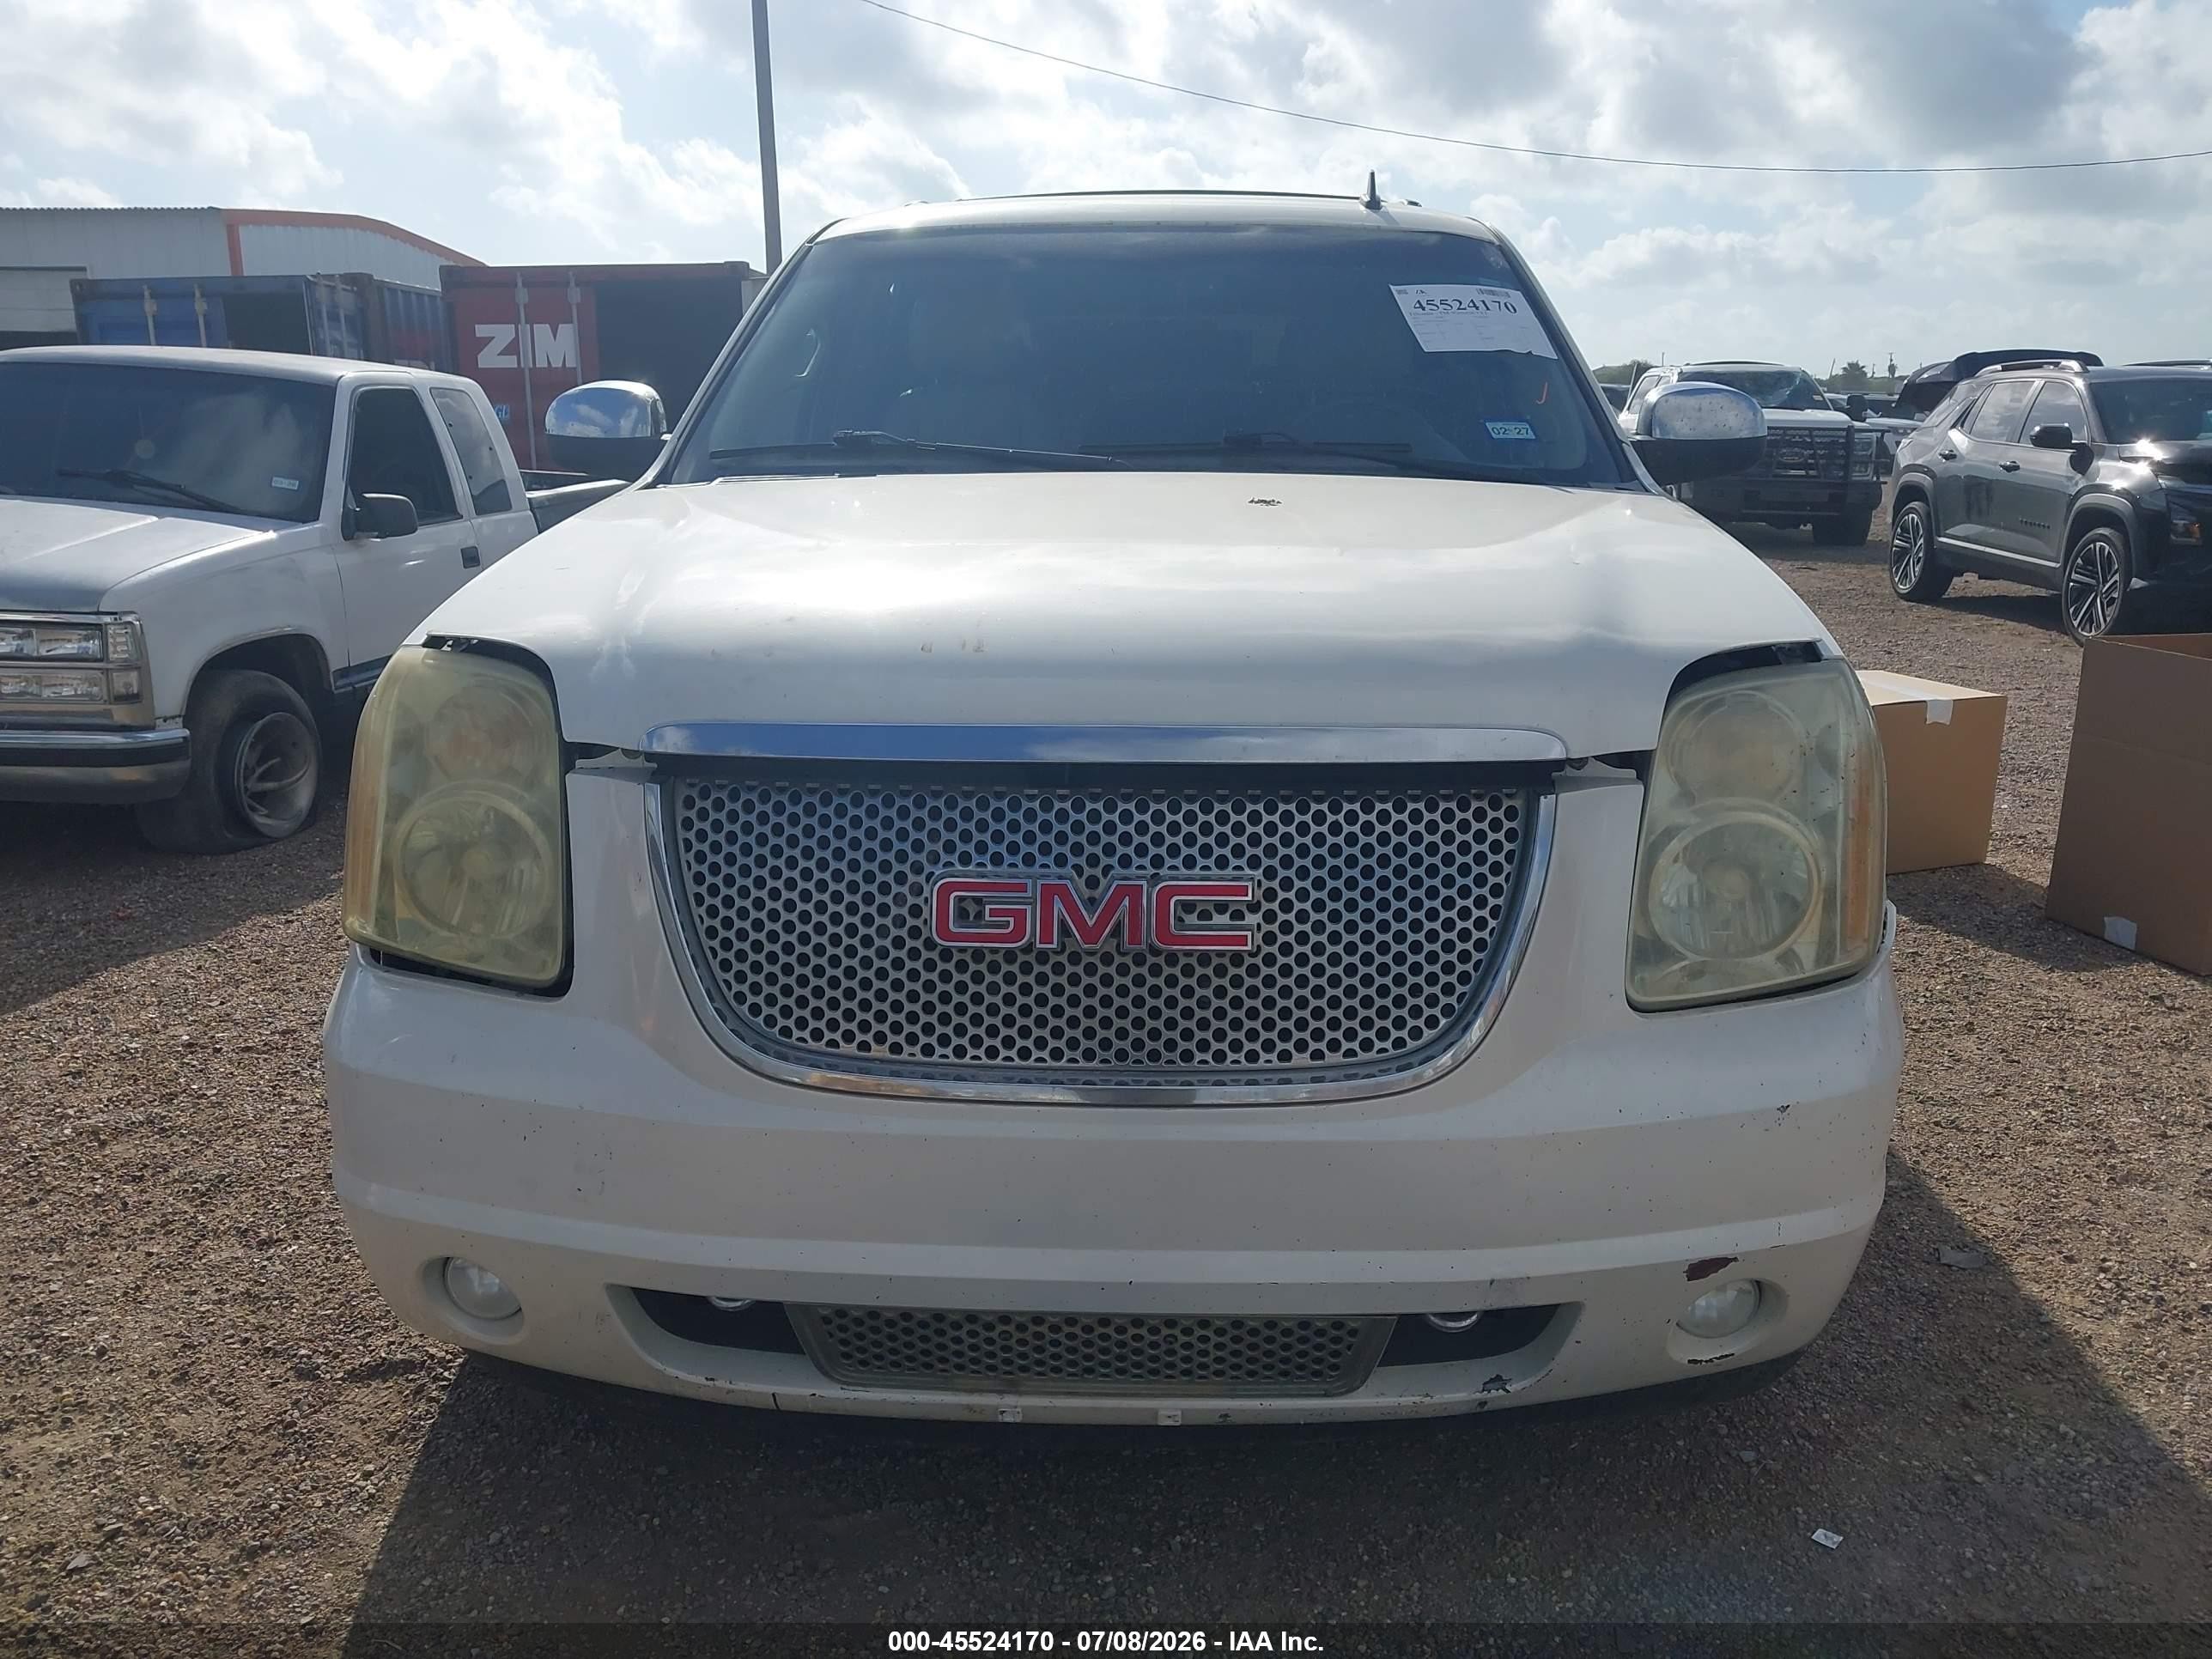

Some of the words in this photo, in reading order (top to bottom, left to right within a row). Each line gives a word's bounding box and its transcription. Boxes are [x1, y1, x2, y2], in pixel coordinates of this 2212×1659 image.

[1413, 299, 1517, 314] 45524170
[475, 324, 579, 368] ZIM
[932, 878, 1254, 950] GMC
